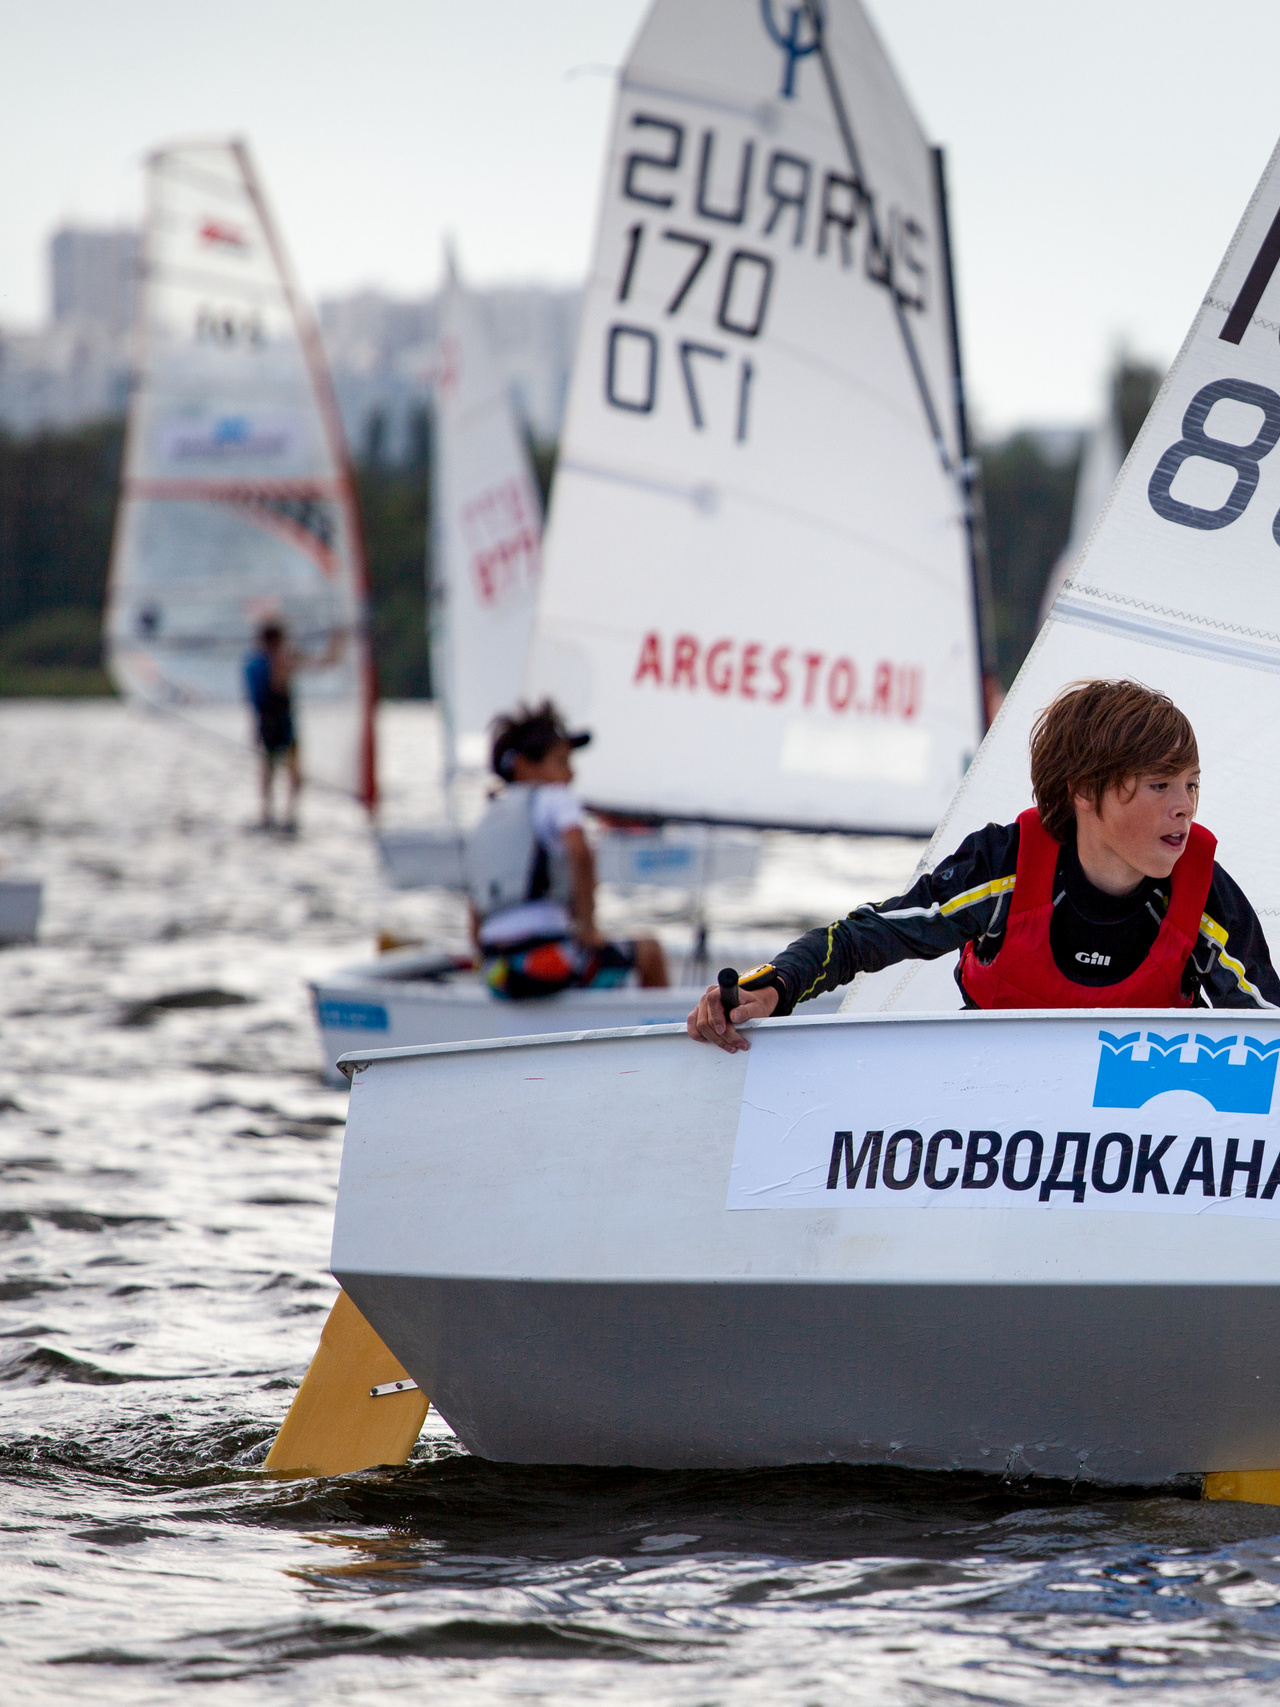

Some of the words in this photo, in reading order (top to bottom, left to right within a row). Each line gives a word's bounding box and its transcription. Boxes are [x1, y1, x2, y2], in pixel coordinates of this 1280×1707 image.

[619, 220, 776, 339] 170
[633, 630, 923, 720] ARGESTO.RU
[1075, 951, 1112, 967] Gill
